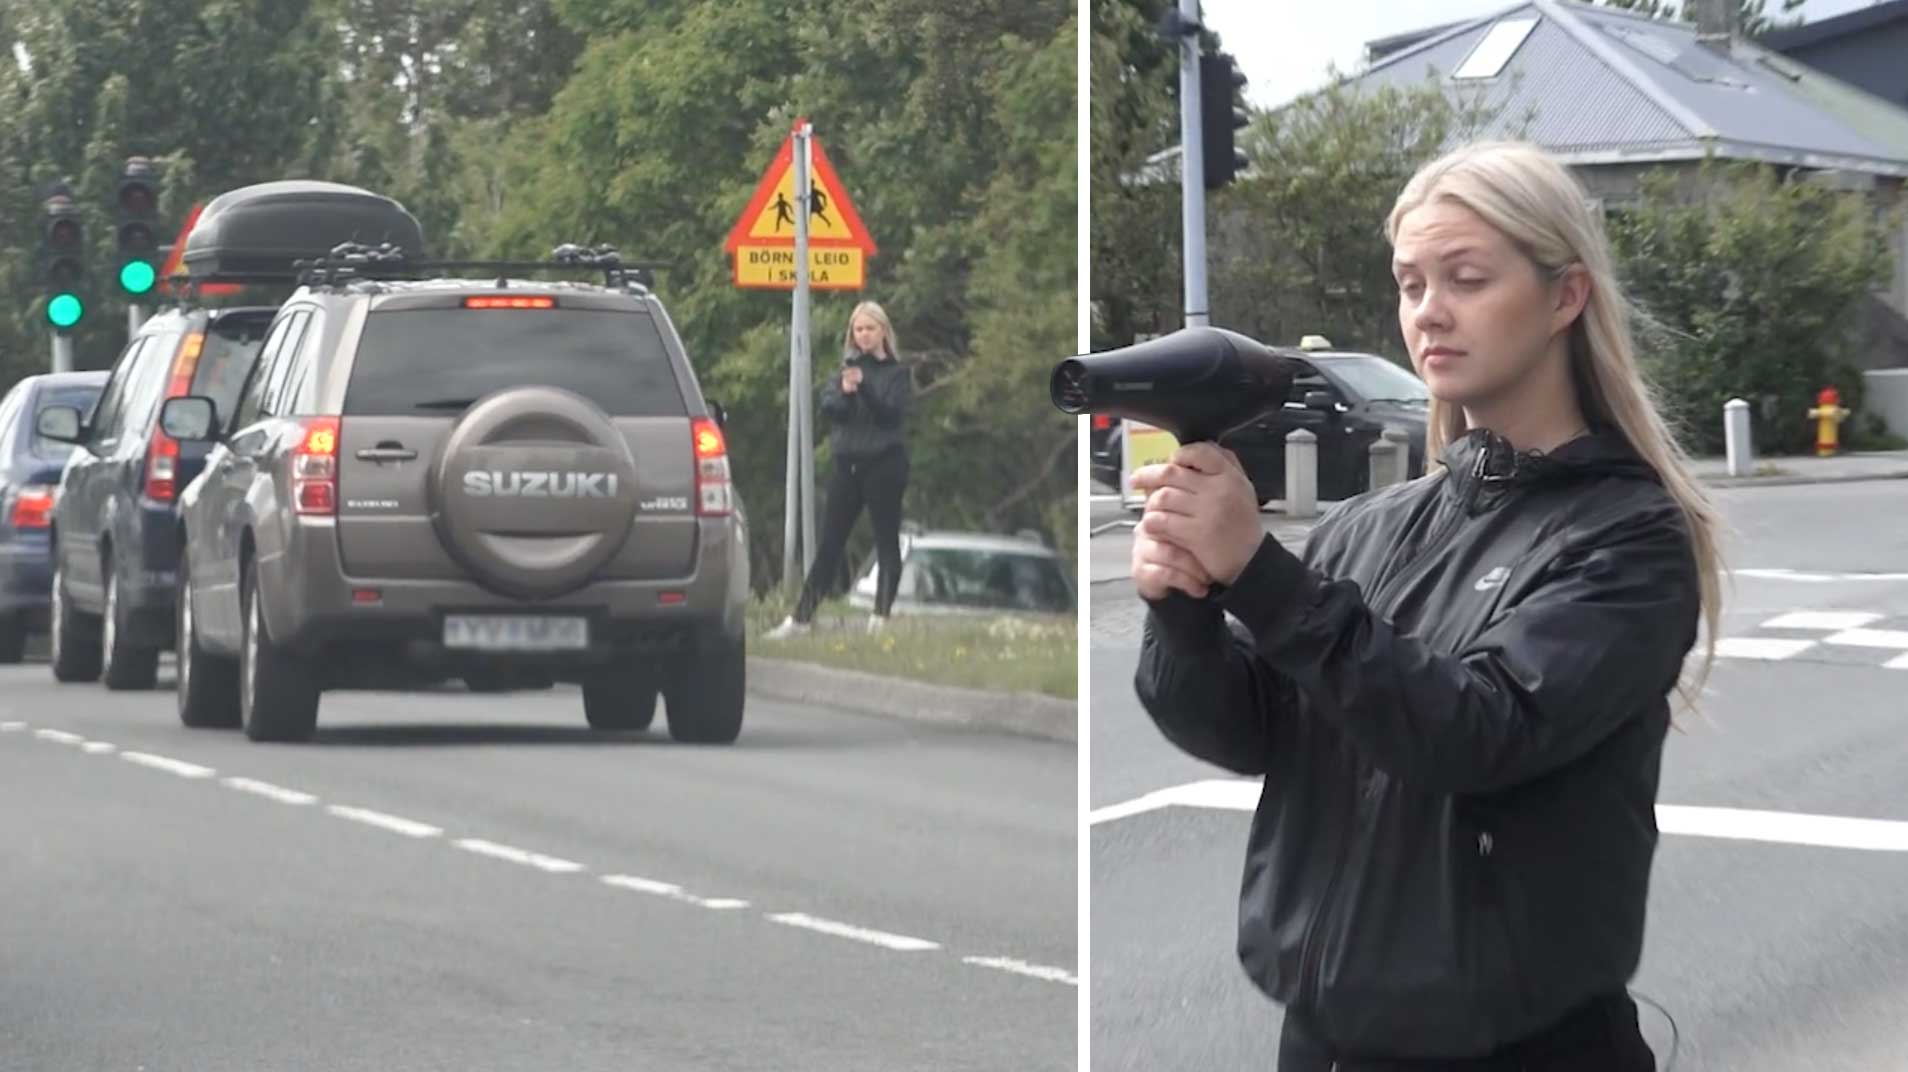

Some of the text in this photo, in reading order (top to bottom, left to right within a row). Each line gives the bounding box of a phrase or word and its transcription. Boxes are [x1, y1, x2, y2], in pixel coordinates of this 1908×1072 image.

[749, 249, 793, 264] BÖRN
[778, 269, 829, 282] SKLA
[463, 470, 618, 498] SUZUKI
